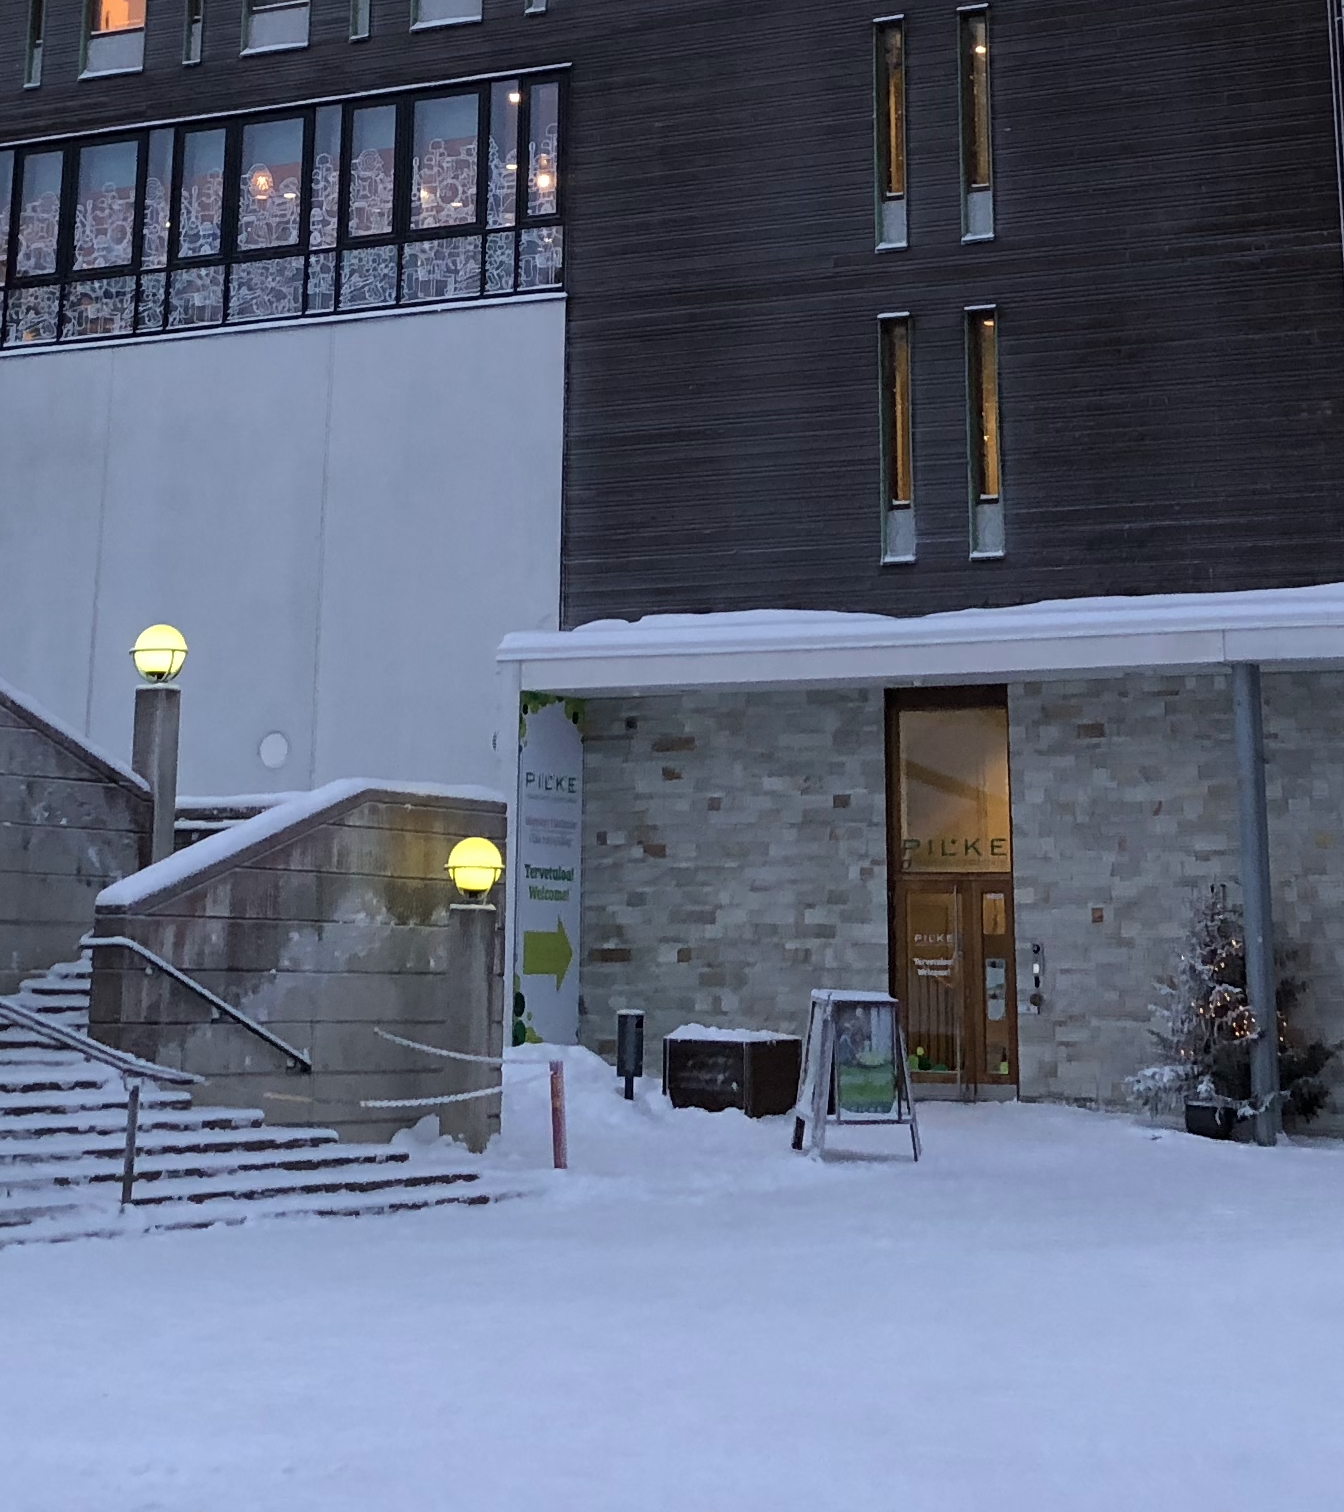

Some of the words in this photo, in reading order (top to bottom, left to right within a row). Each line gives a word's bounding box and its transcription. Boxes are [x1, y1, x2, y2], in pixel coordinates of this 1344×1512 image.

[525, 772, 577, 794] PILKE
[903, 838, 1008, 857] PILKE
[914, 934, 954, 943] PILKE
